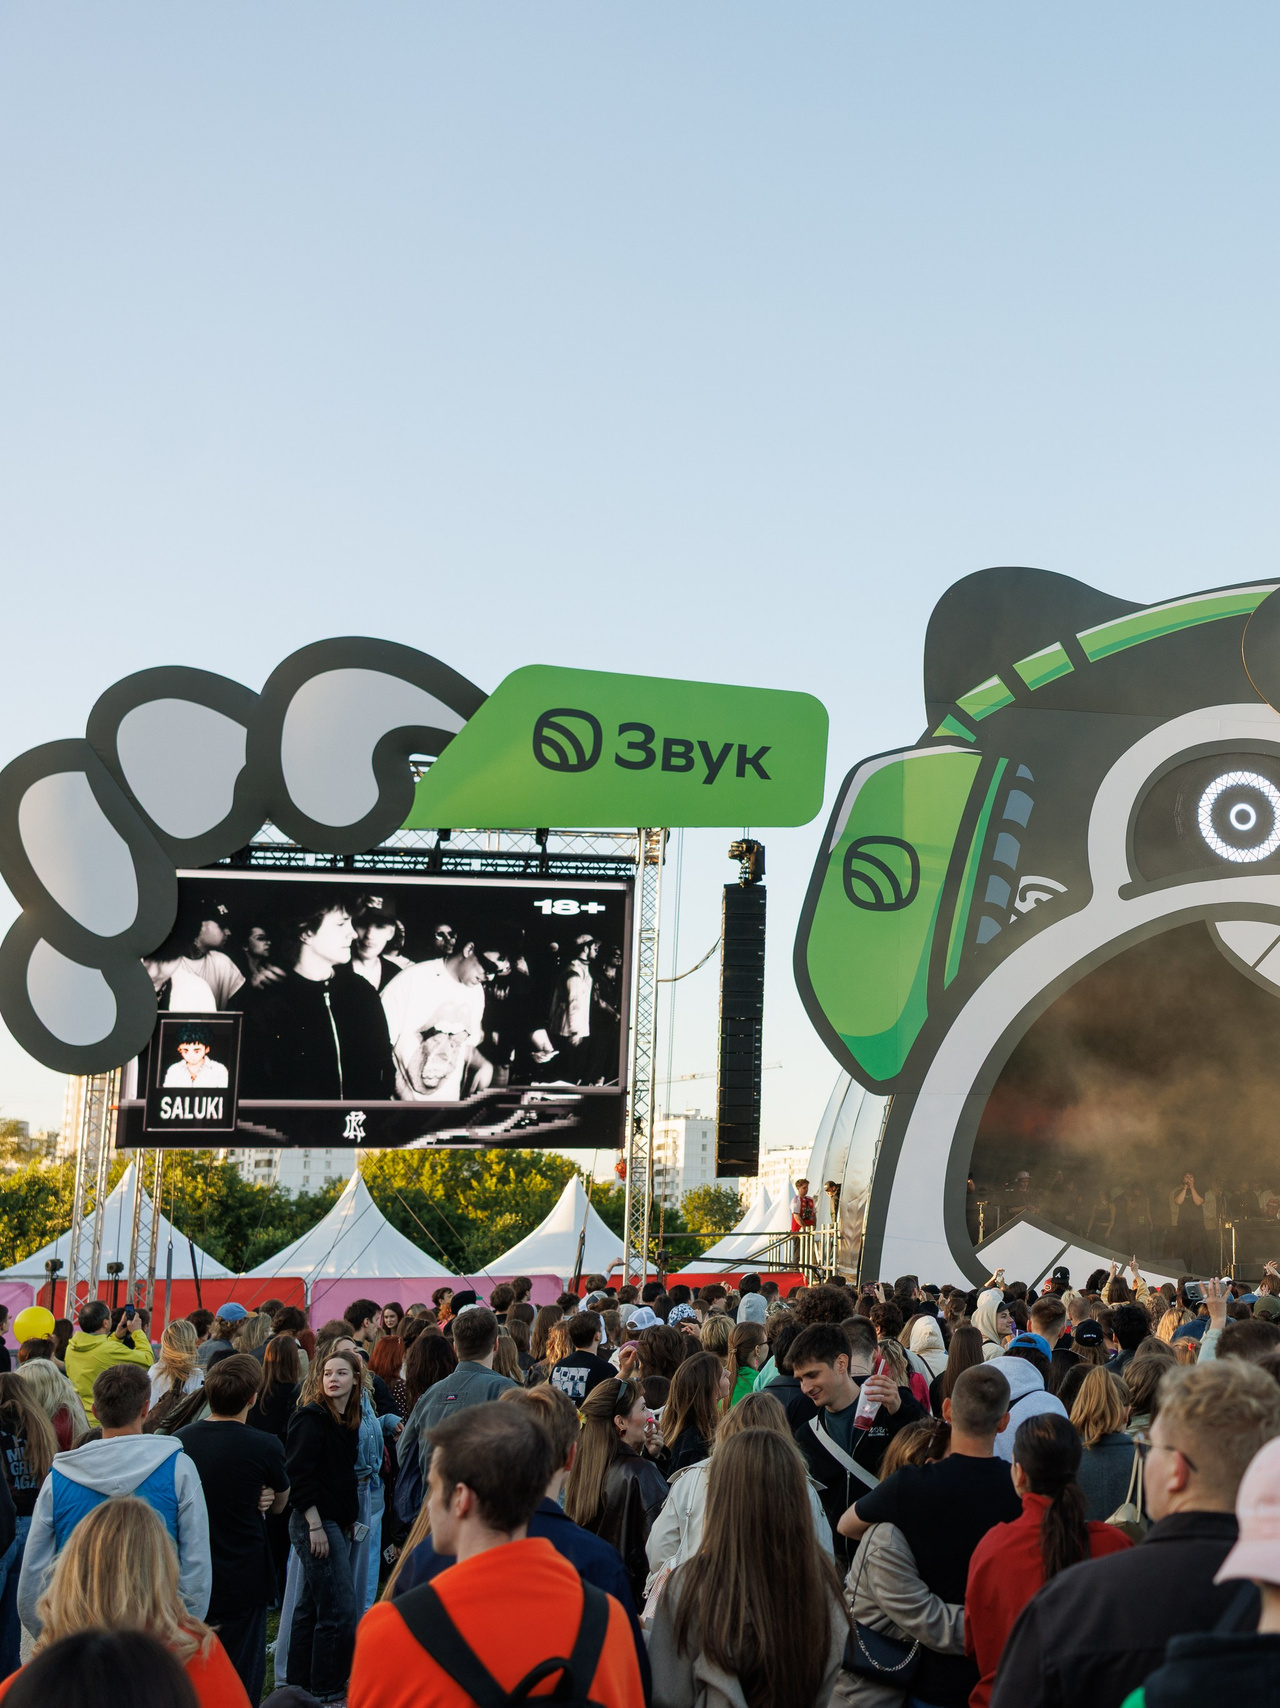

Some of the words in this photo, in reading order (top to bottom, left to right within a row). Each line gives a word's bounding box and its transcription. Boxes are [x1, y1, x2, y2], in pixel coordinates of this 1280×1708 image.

[615, 722, 772, 785] Звук
[534, 899, 606, 916] 18+
[160, 1096, 223, 1120] SALUKI
